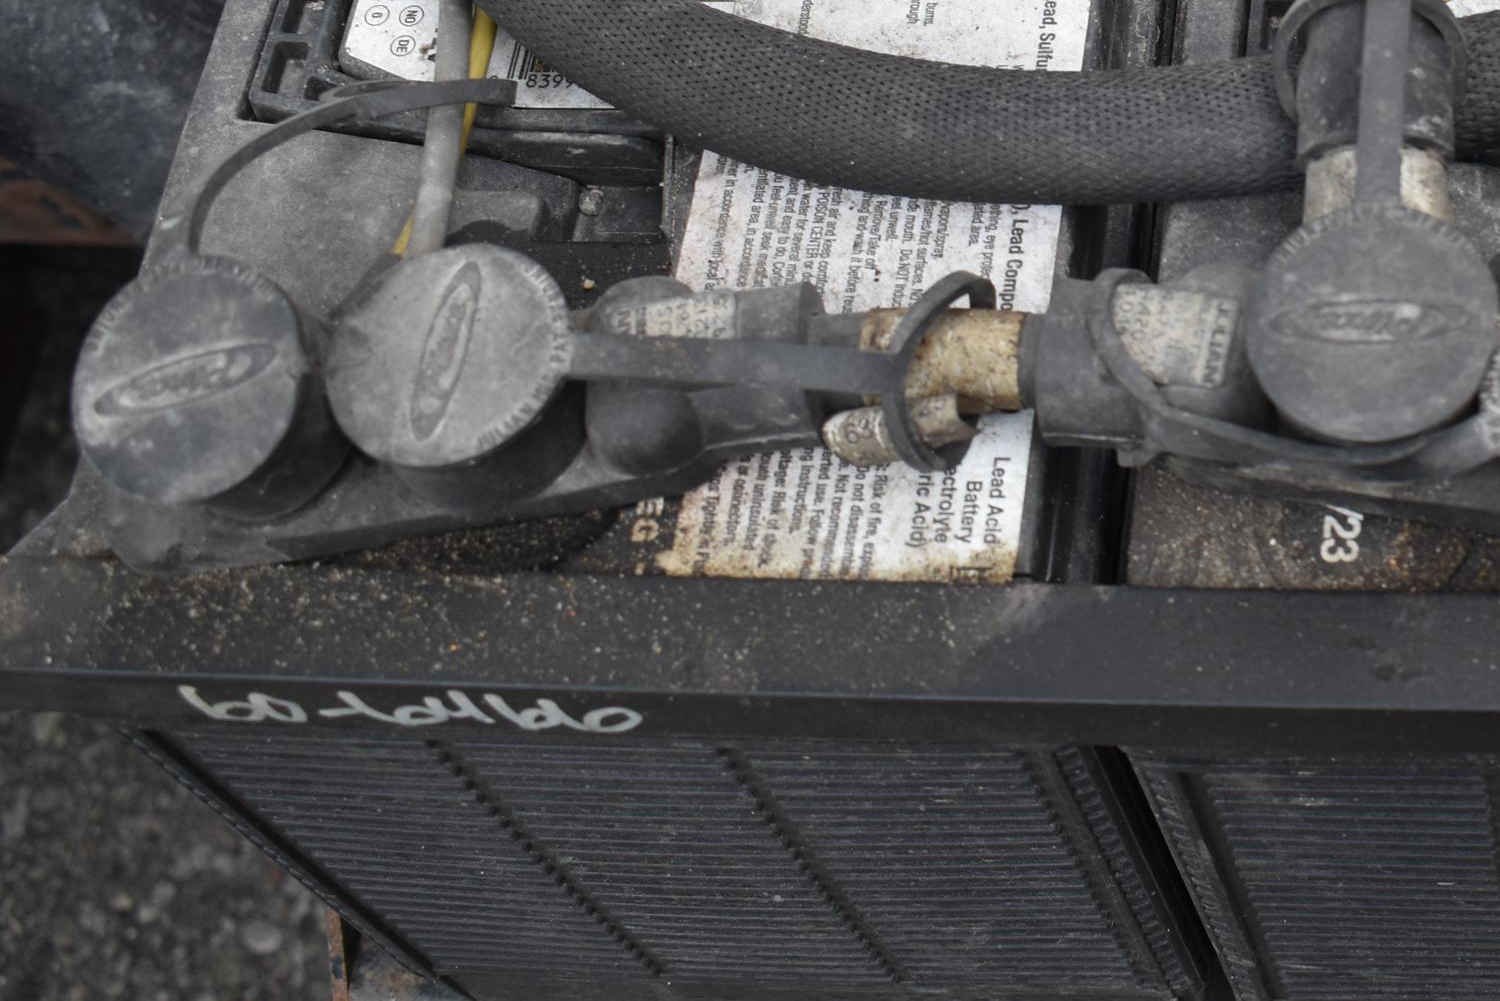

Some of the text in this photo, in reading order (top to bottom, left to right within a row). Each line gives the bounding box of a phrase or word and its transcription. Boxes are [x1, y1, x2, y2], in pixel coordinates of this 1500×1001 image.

[405, 9, 418, 23] NO
[397, 39, 410, 53] DE
[1009, 219, 1028, 253] Lead
[955, 481, 982, 543] Battery
[983, 457, 1010, 543] Lead Acid
[906, 502, 929, 548] Acid)
